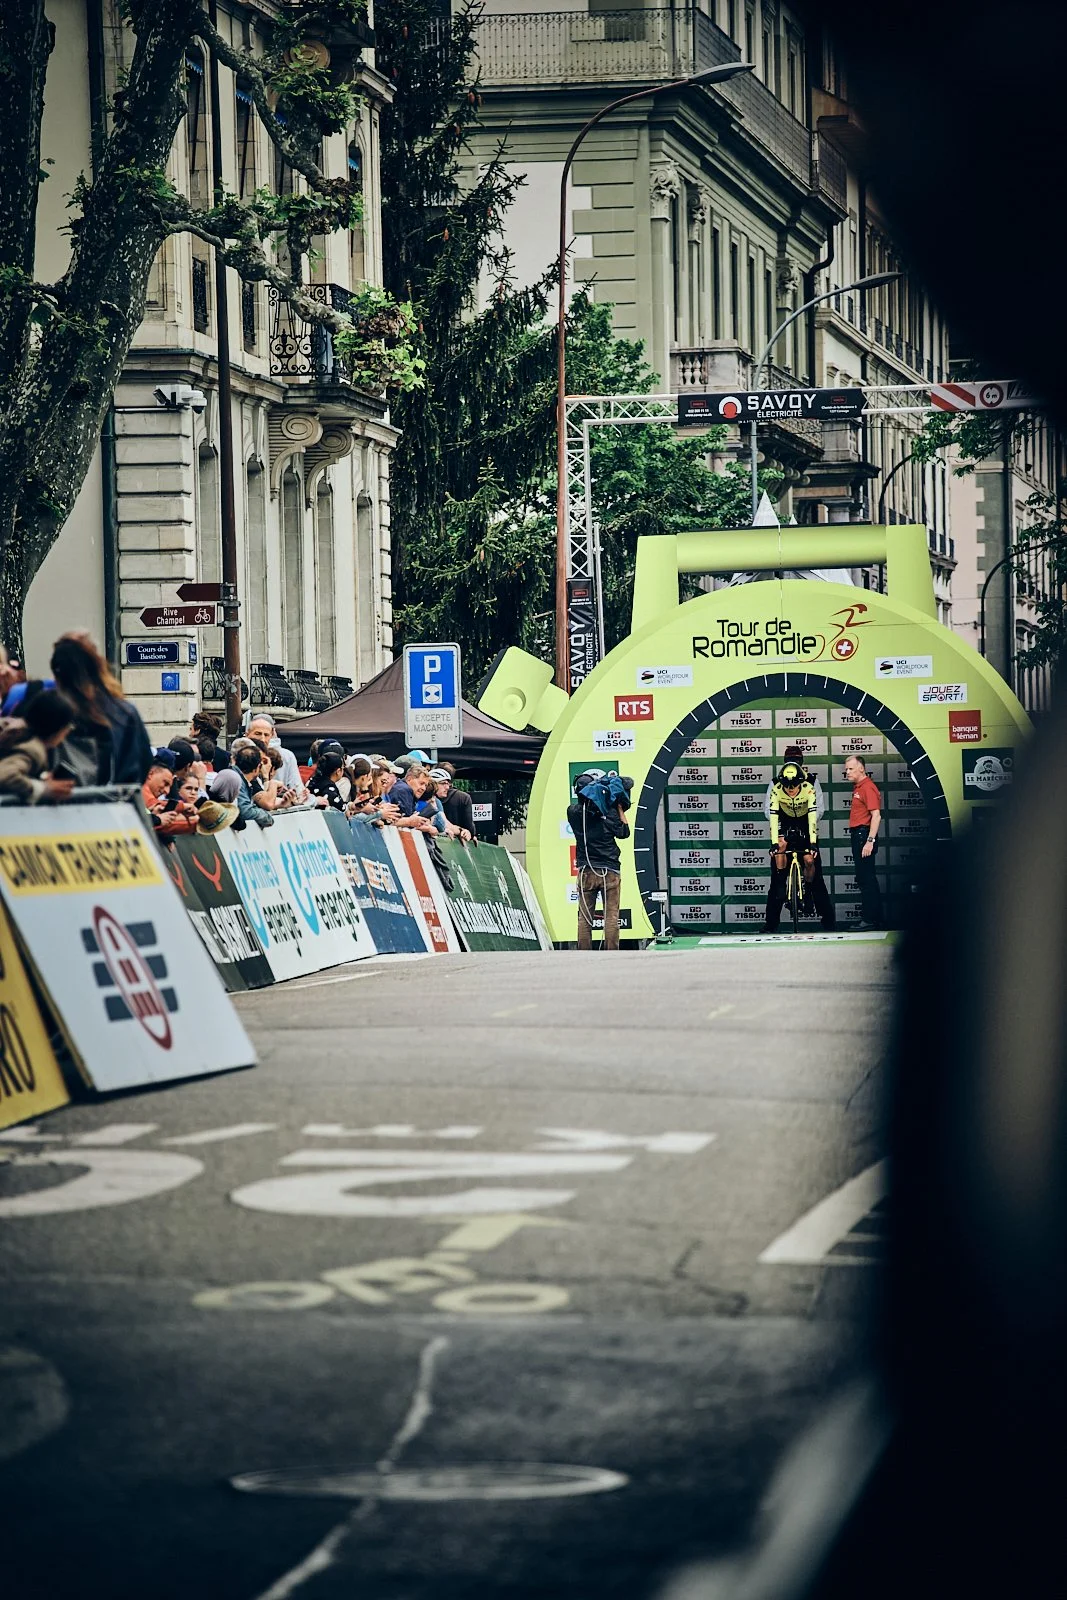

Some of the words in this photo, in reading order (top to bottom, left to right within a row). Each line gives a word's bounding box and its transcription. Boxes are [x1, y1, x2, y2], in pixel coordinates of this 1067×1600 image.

[985, 391, 990, 399] 6
[747, 393, 817, 411] SAVOY
[756, 409, 803, 419] ÉLECTRICITÉ
[163, 607, 179, 616] Rive
[156, 616, 185, 626] Champel
[716, 619, 760, 638] Tour
[765, 617, 792, 636] de
[157, 645, 169, 653] des
[692, 632, 817, 658] Romandie
[570, 620, 585, 688] SAVOY
[585, 632, 593, 677] ECTRICITÉ
[423, 655, 441, 683] P
[923, 685, 961, 694] JOUEZ
[922, 693, 964, 702] SPORT!
[618, 701, 651, 716] RTS
[415, 713, 452, 722] EXCEPTE
[413, 723, 453, 732] MACARON
[952, 725, 978, 733] banque
[431, 734, 436, 742] E
[957, 731, 979, 739] léman
[314, 877, 360, 942] energie
